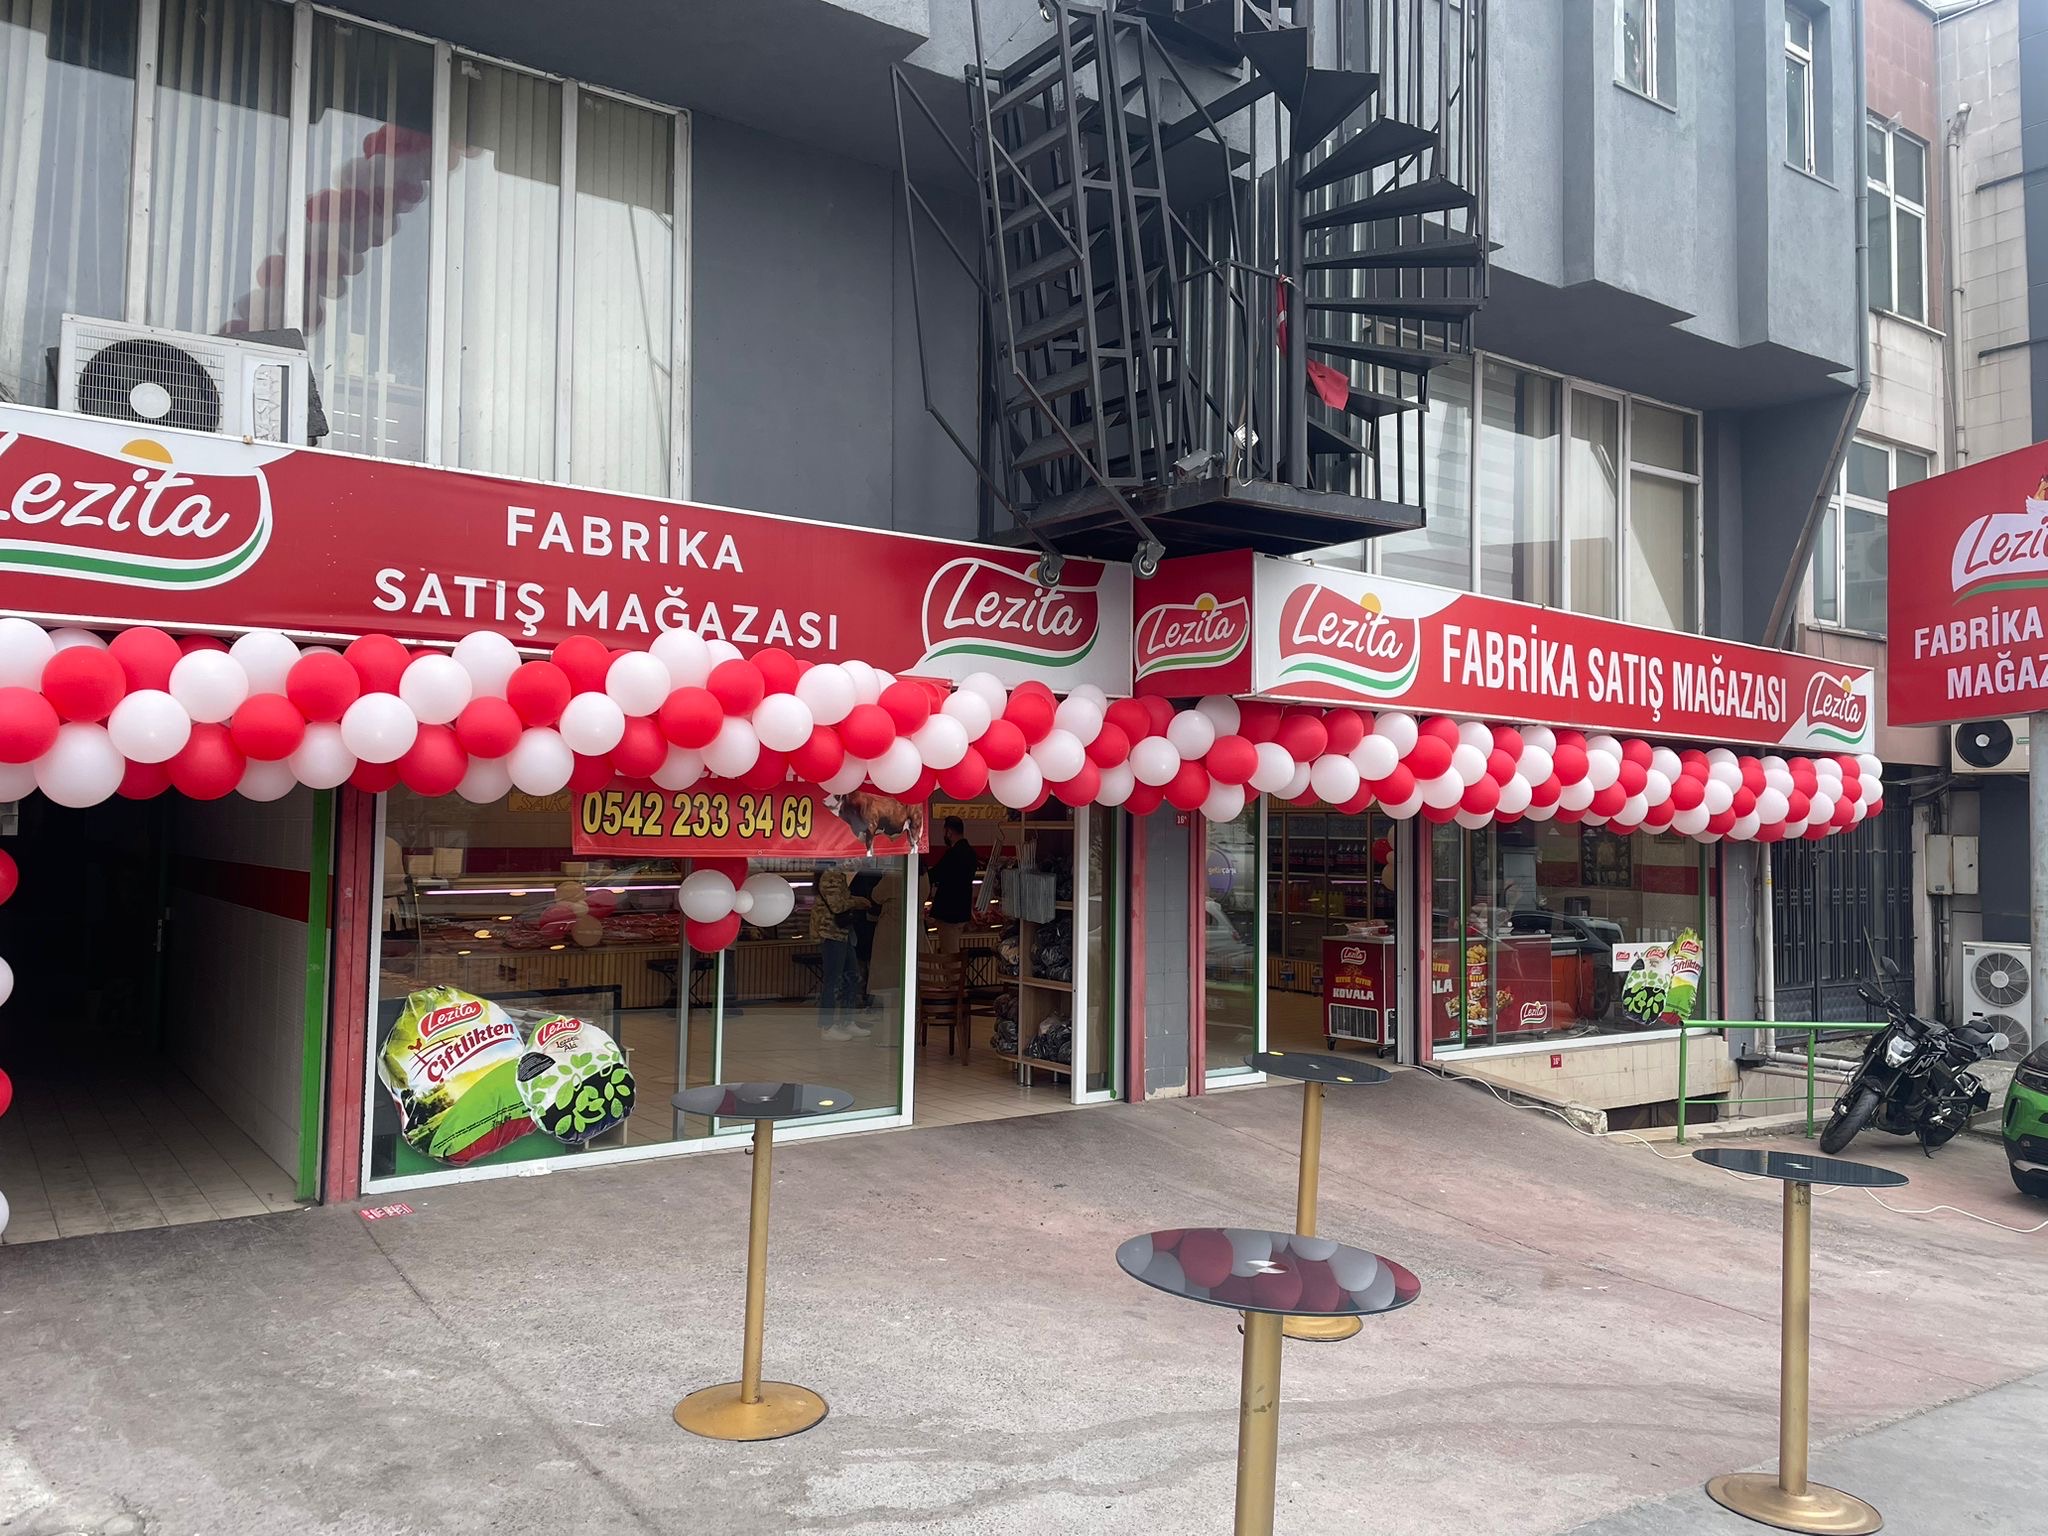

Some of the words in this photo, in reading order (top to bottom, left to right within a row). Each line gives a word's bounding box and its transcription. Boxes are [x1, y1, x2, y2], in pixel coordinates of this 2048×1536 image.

[507, 506, 743, 573] FABRİKA
[372, 567, 546, 637] SATIŞ
[567, 585, 837, 650] MAĞAZASI
[943, 563, 1083, 636] Lezita
[1292, 583, 1403, 659] Lezita
[1147, 606, 1236, 655] Lezita
[1914, 605, 2044, 661] FABRİKA
[1442, 624, 1579, 699] FABRİKA
[1588, 647, 1664, 723] SATIŞ
[1673, 653, 1787, 723] MAĞAZASI
[1812, 674, 1862, 724] Lezita
[582, 791, 664, 836] 0542
[672, 793, 730, 837] 233
[738, 794, 774, 838] 34
[780, 796, 813, 839] 69
[428, 1003, 477, 1032] Lezita
[1333, 988, 1375, 1001] KOVALA
[427, 1022, 514, 1084] Çiftlikten
